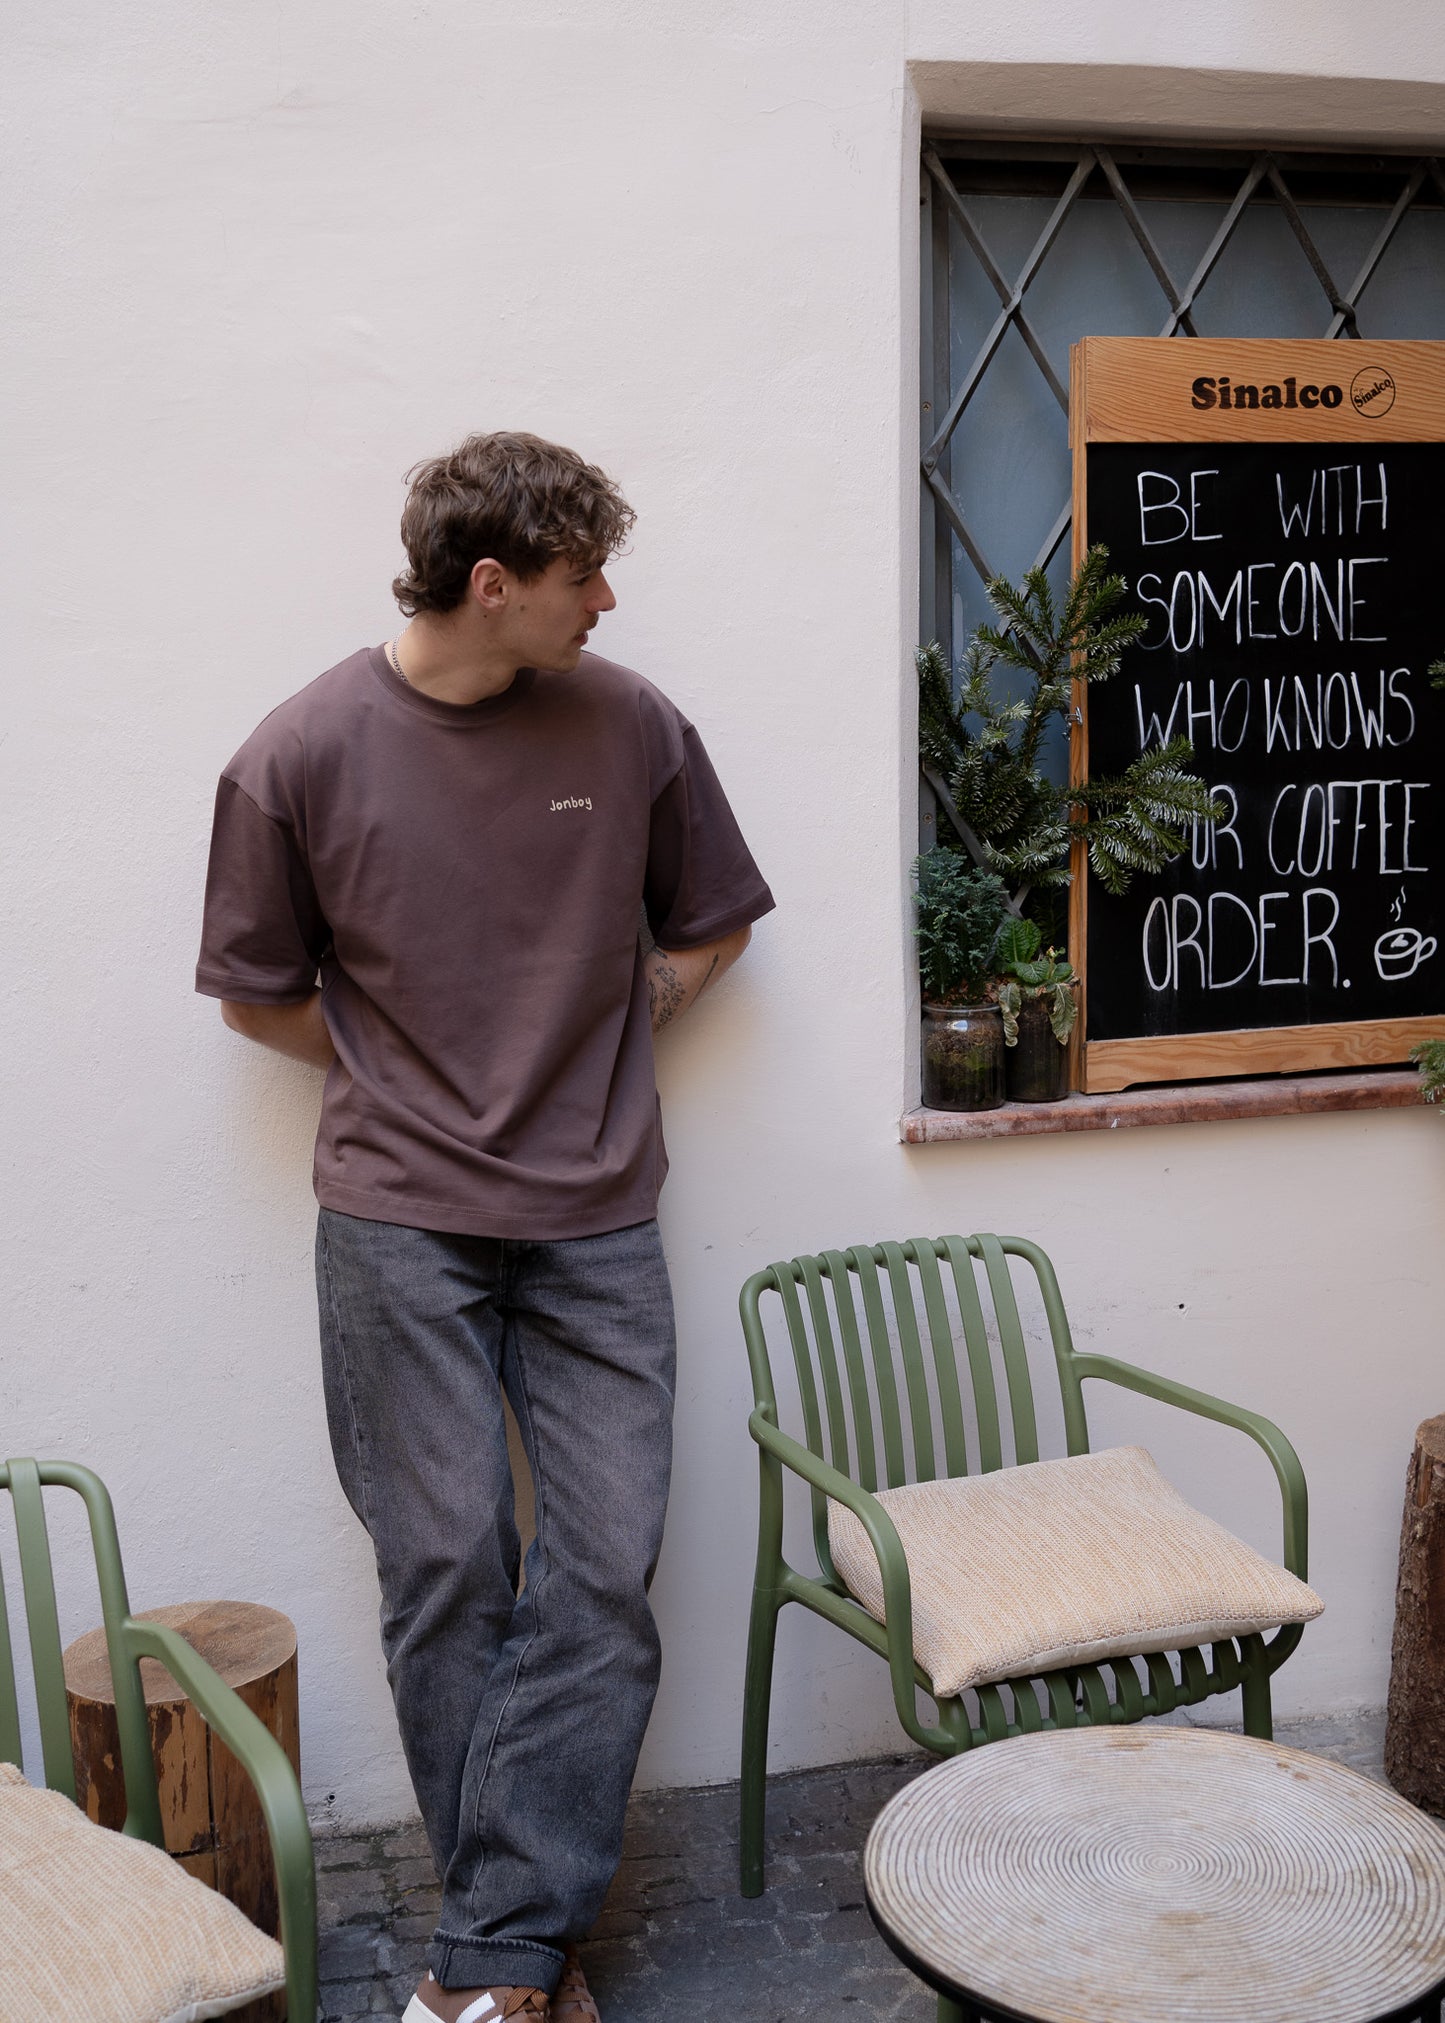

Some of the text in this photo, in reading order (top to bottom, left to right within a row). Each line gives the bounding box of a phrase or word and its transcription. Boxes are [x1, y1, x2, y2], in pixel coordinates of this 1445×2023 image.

[1191, 377, 1343, 411] Sinalco
[1137, 463, 1387, 545] BE WITH
[1135, 557, 1388, 653] SOMEONE
[1135, 668, 1415, 753] WHO KNOWS
[550, 796, 593, 811] Jonboy
[1150, 779, 1431, 877] UR COFFEE
[1142, 887, 1352, 992] ORDER.
